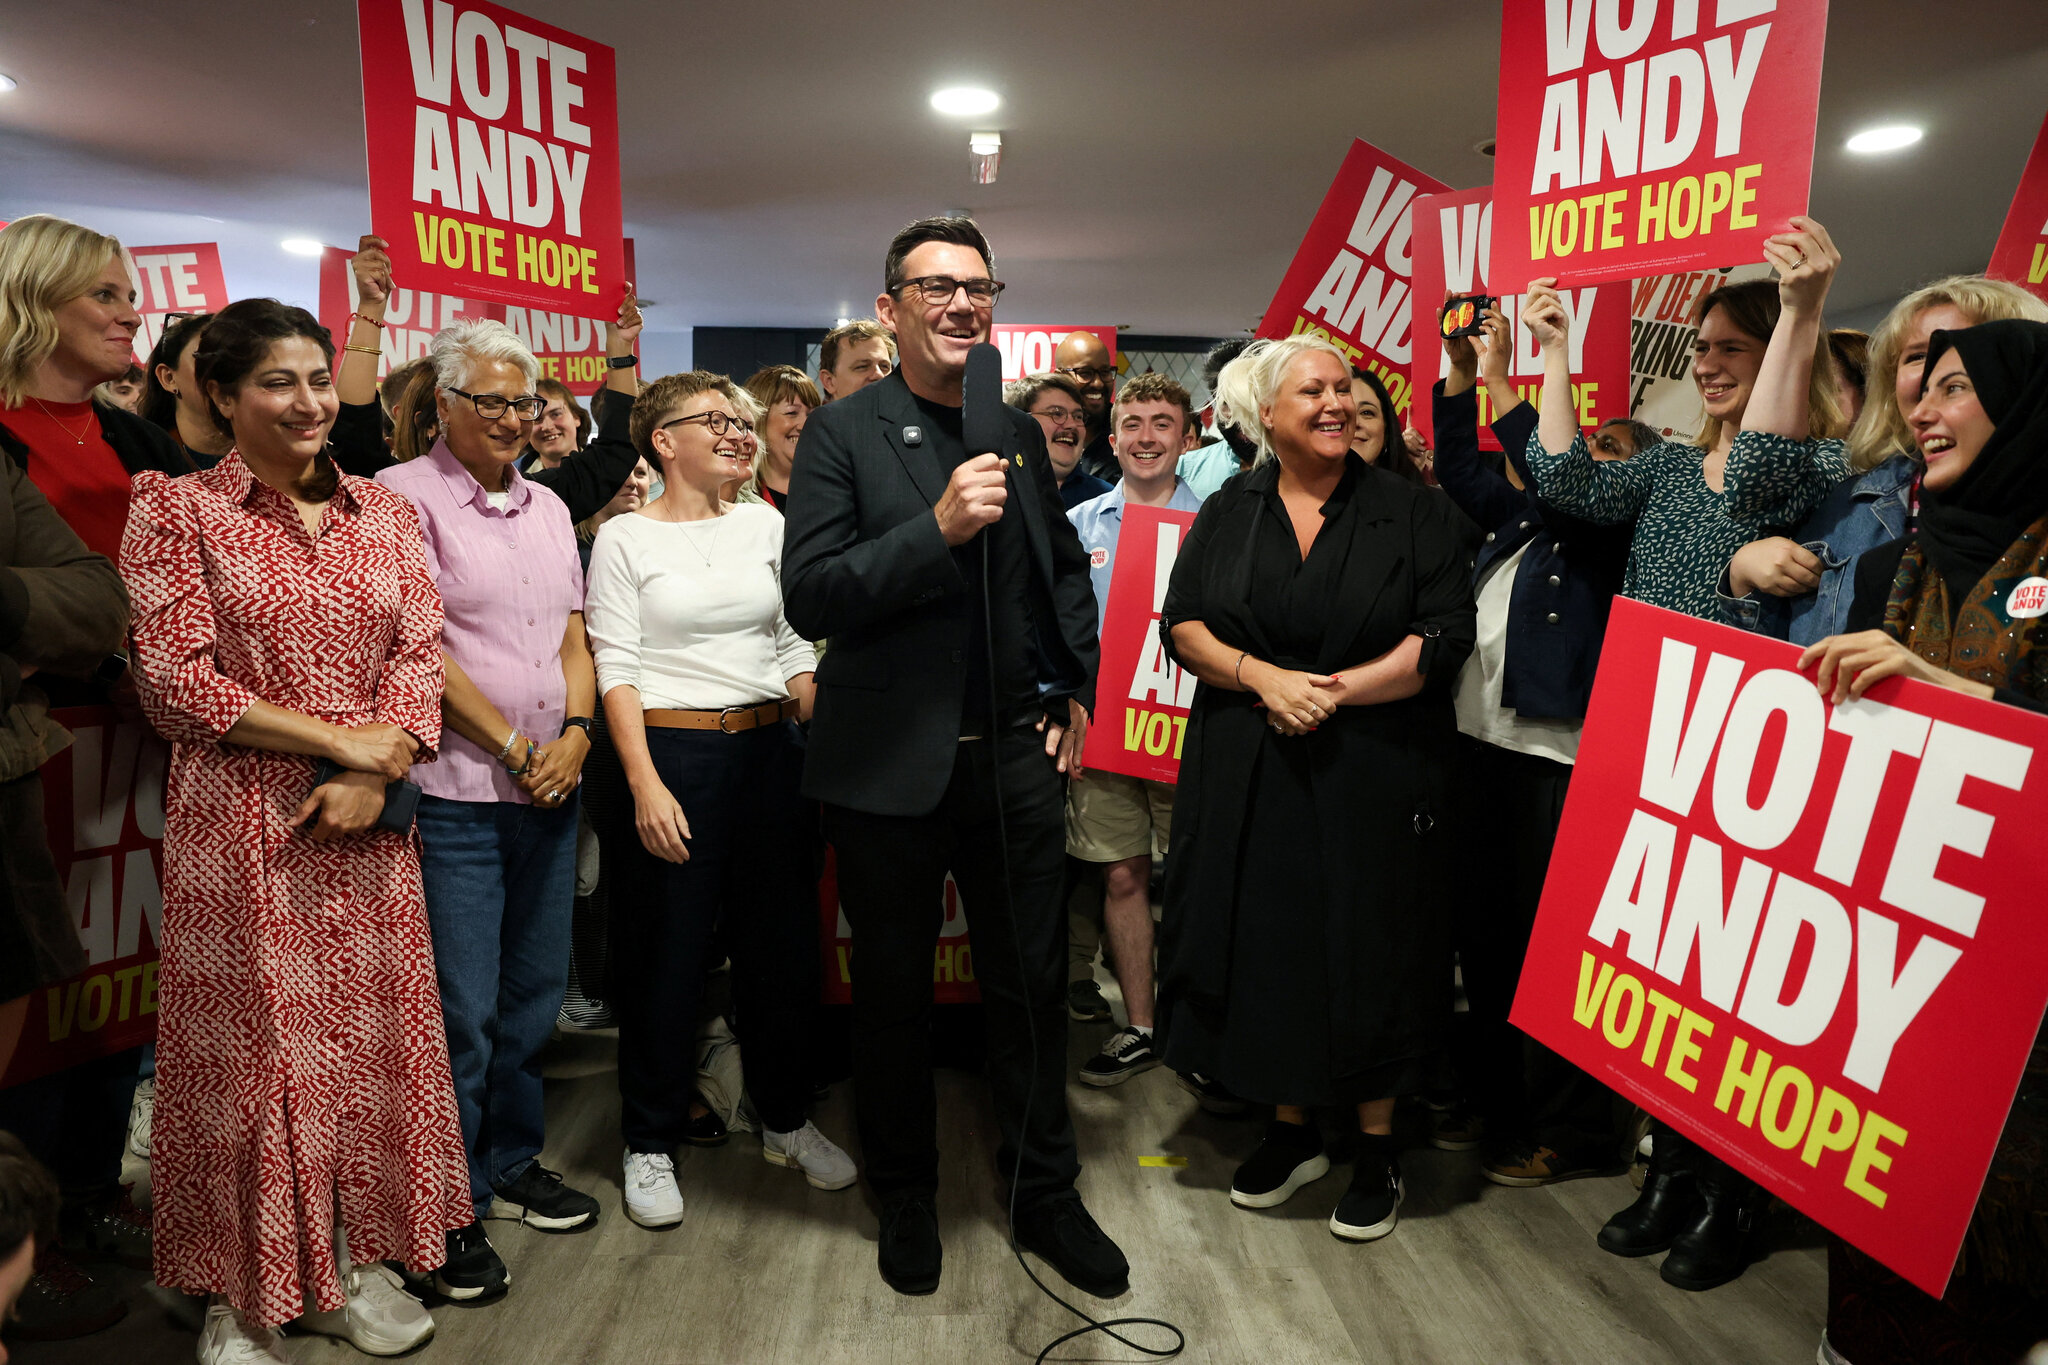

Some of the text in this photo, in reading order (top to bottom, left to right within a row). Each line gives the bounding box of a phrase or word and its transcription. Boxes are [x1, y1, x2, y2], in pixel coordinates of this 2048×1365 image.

[402, 0, 592, 148] VOTE
[1530, 22, 1772, 195] ANDY
[412, 105, 590, 238] ANDY
[1529, 189, 1628, 260] VOTE
[1637, 163, 1762, 244] HOPE
[413, 211, 599, 294] VOTE HOPE
[566, 356, 607, 382] HOP
[2012, 598, 2044, 610] ANDY
[2016, 586, 2048, 599] VOTE
[1124, 707, 1189, 760] VOT
[1639, 636, 2034, 939] VOTE
[1587, 808, 1964, 1095] ANDY
[1572, 950, 1714, 1093] VOTE
[1714, 1036, 1908, 1210] HOPE
